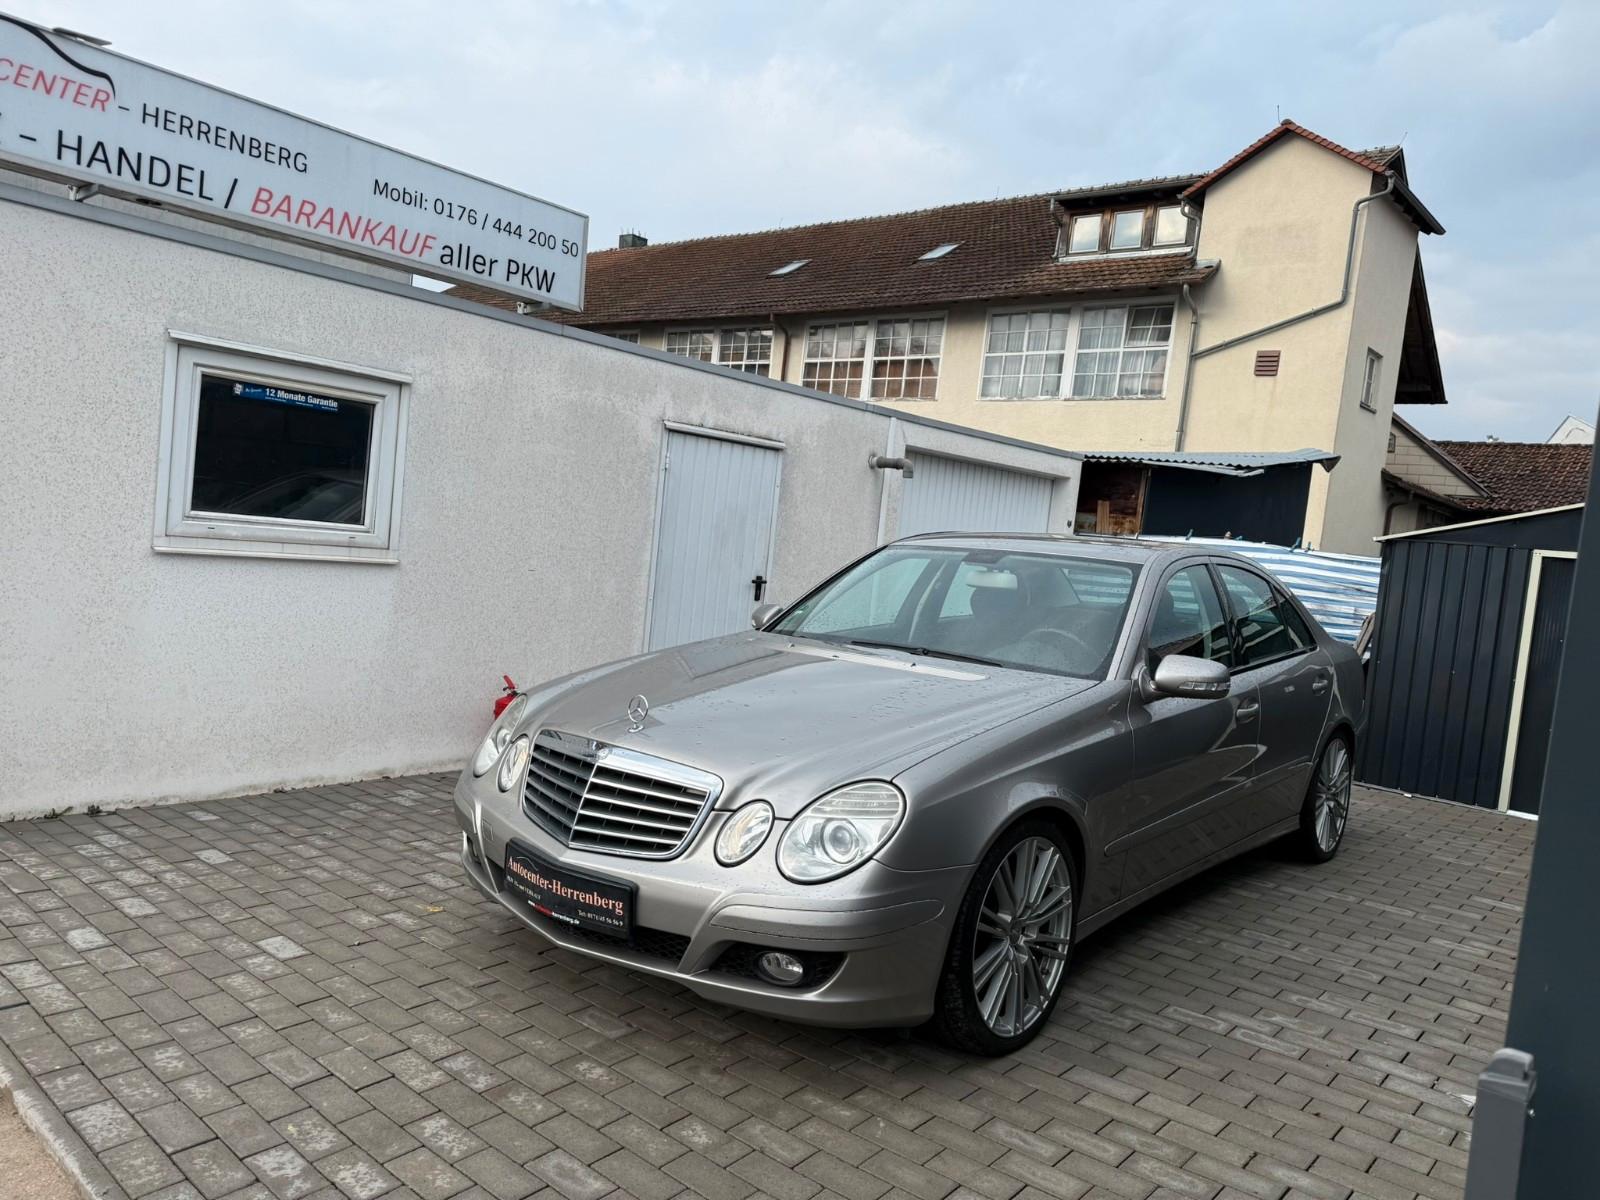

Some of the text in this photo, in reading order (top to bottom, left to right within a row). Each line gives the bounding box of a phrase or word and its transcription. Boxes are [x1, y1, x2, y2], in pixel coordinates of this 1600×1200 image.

[142, 103, 308, 174] HERRENBERG
[251, 186, 437, 258] BARANKAUF
[439, 243, 498, 277] aller
[506, 258, 556, 293] PKW
[373, 178, 428, 212] Mobil:
[433, 198, 477, 226] 0176
[493, 217, 522, 240] 444
[528, 228, 557, 250] 200
[561, 239, 579, 258] 50
[265, 387, 276, 397] 12
[277, 390, 306, 403] Monate
[307, 395, 338, 408] Garantie
[508, 856, 623, 915] Autocenter-Herrenberg
